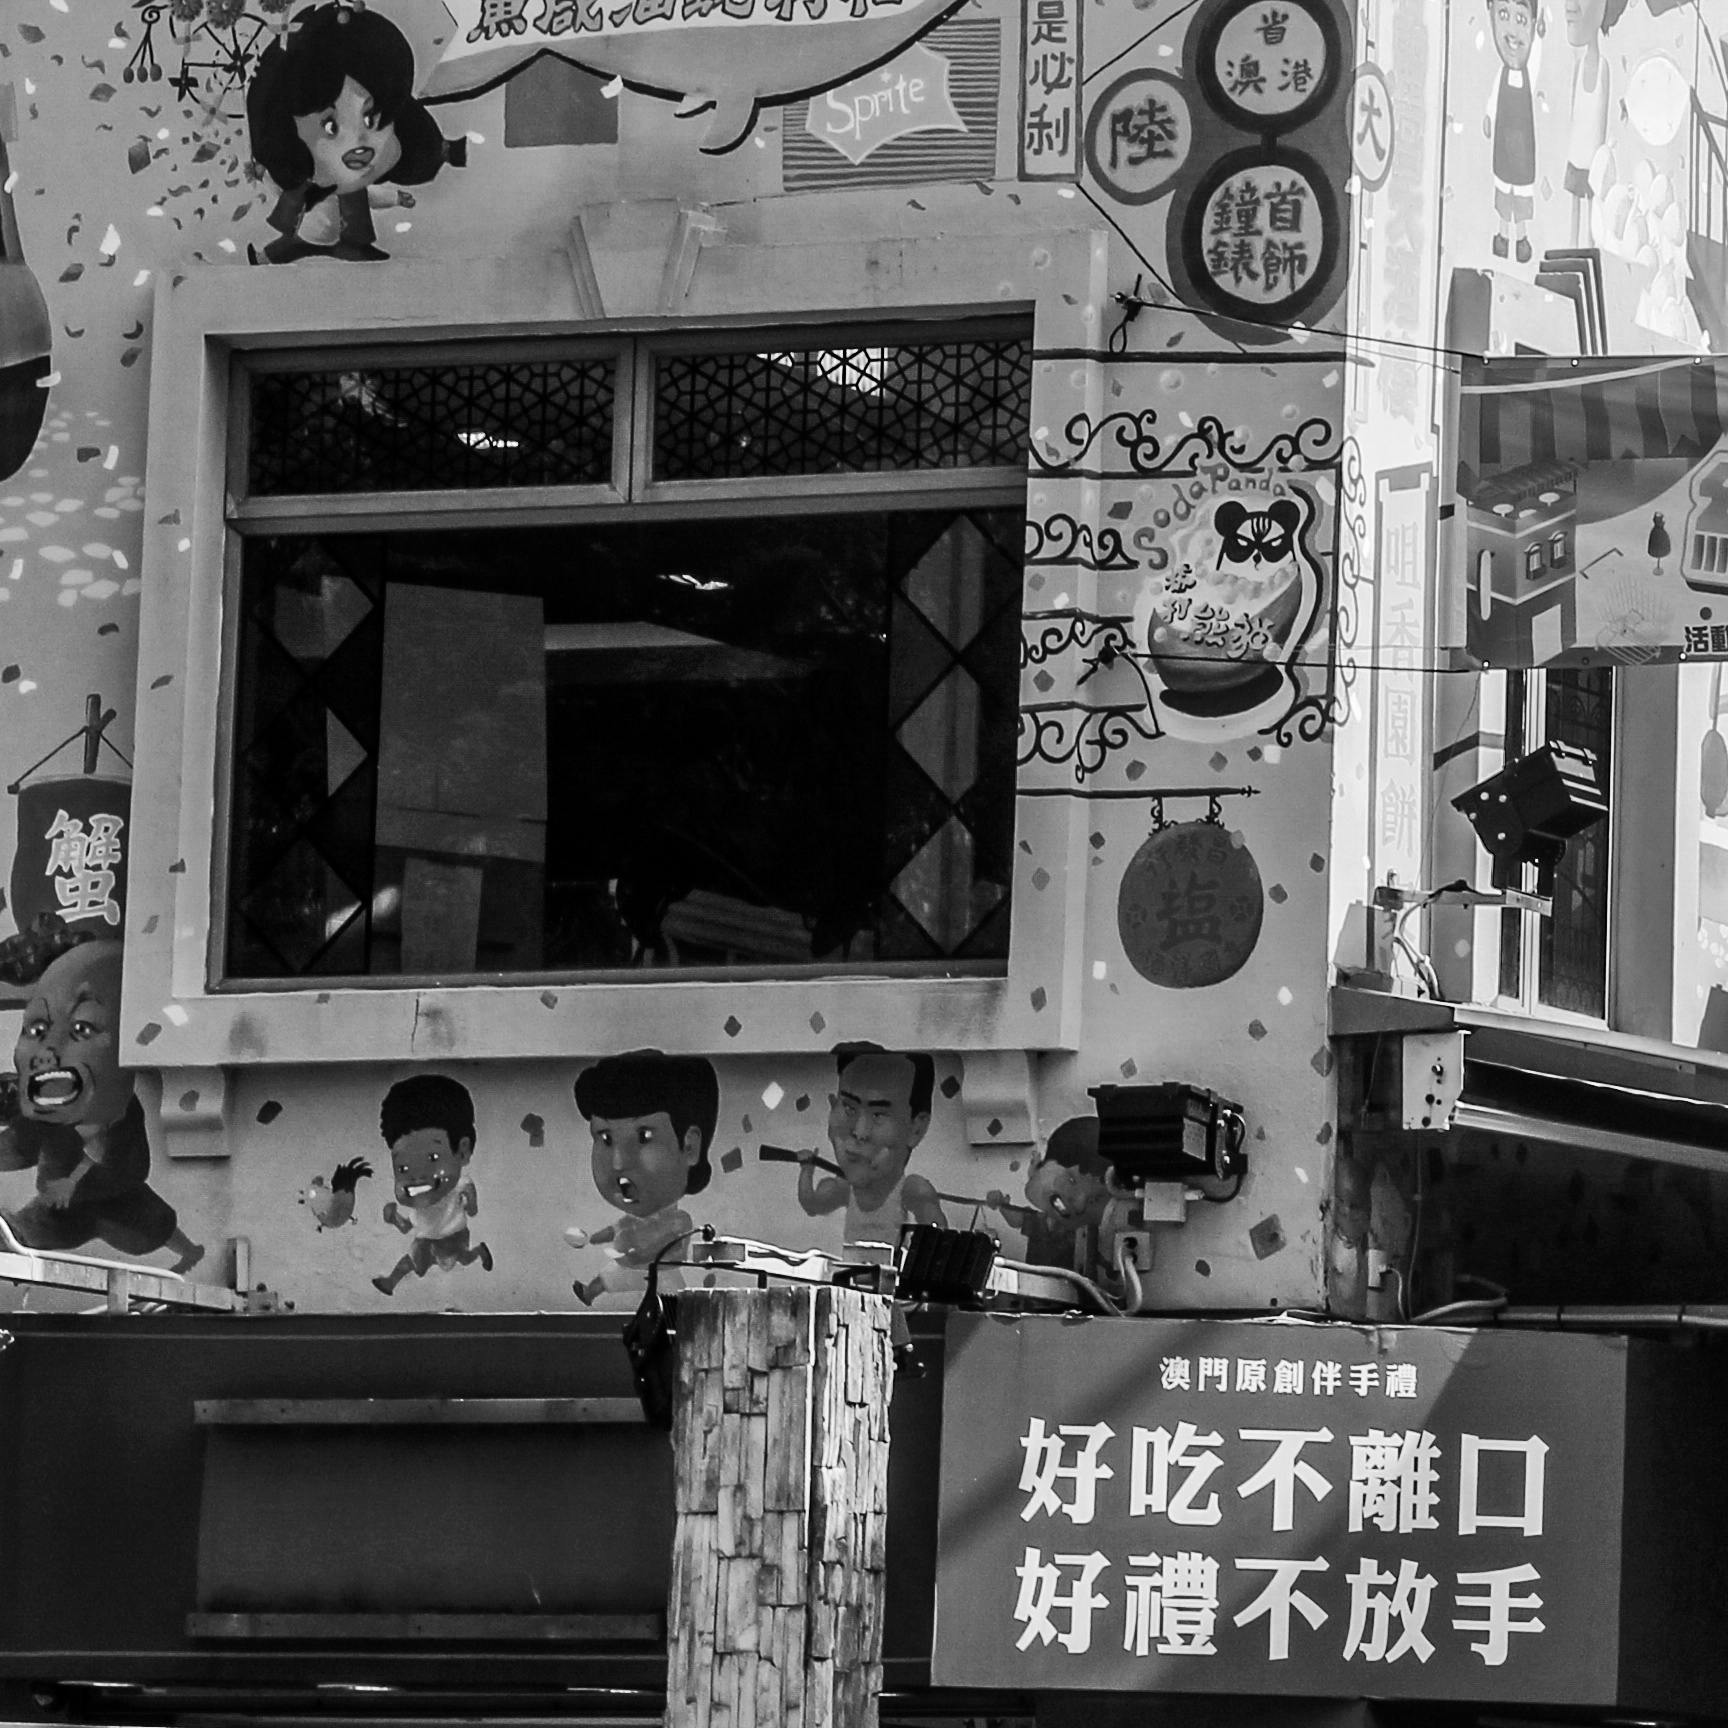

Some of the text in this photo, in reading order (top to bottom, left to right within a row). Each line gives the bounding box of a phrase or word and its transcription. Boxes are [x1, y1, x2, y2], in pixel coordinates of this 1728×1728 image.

[826, 71, 925, 140] Sprite
[1160, 1356, 1420, 1399] 澳門原創伴手禮
[1018, 1416, 1550, 1538] 好吃不離口
[1012, 1545, 1547, 1667] 好禮不放手
